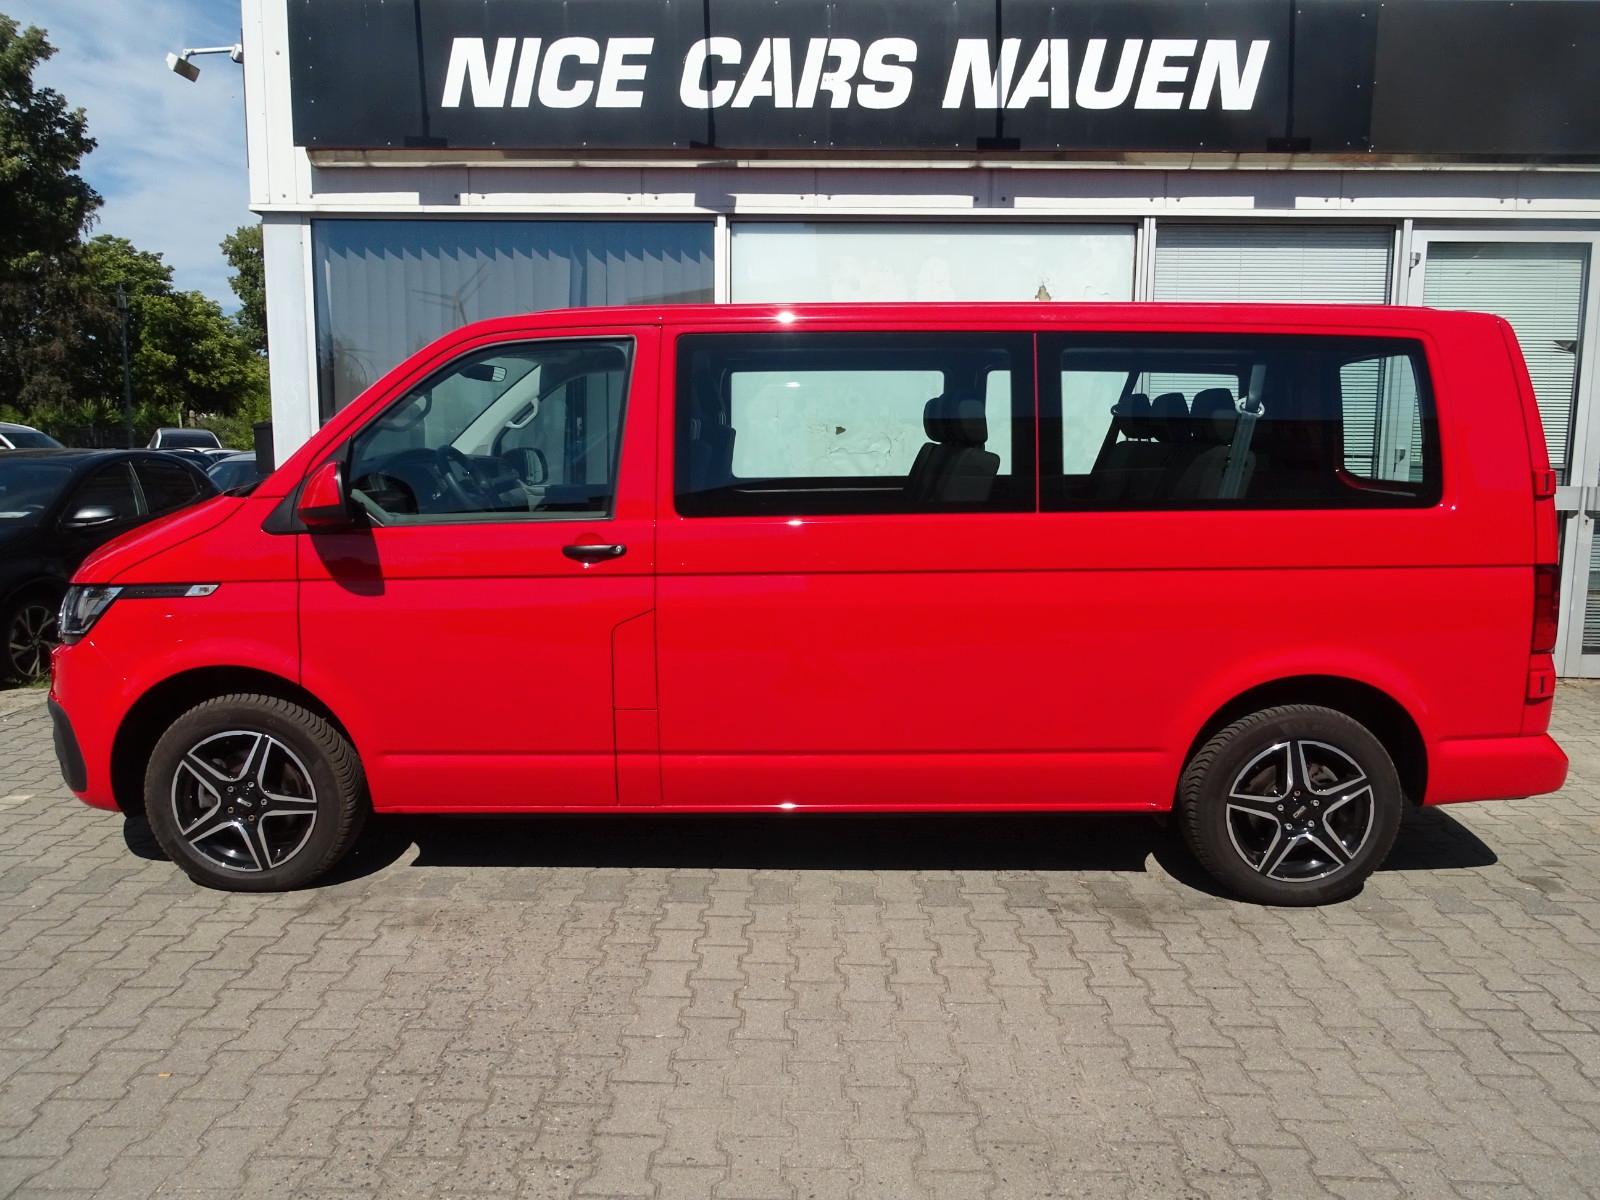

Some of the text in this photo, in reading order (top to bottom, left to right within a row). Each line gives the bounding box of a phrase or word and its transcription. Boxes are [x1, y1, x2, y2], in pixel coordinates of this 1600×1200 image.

[441, 37, 1271, 111] NICE CARS NAUEN
